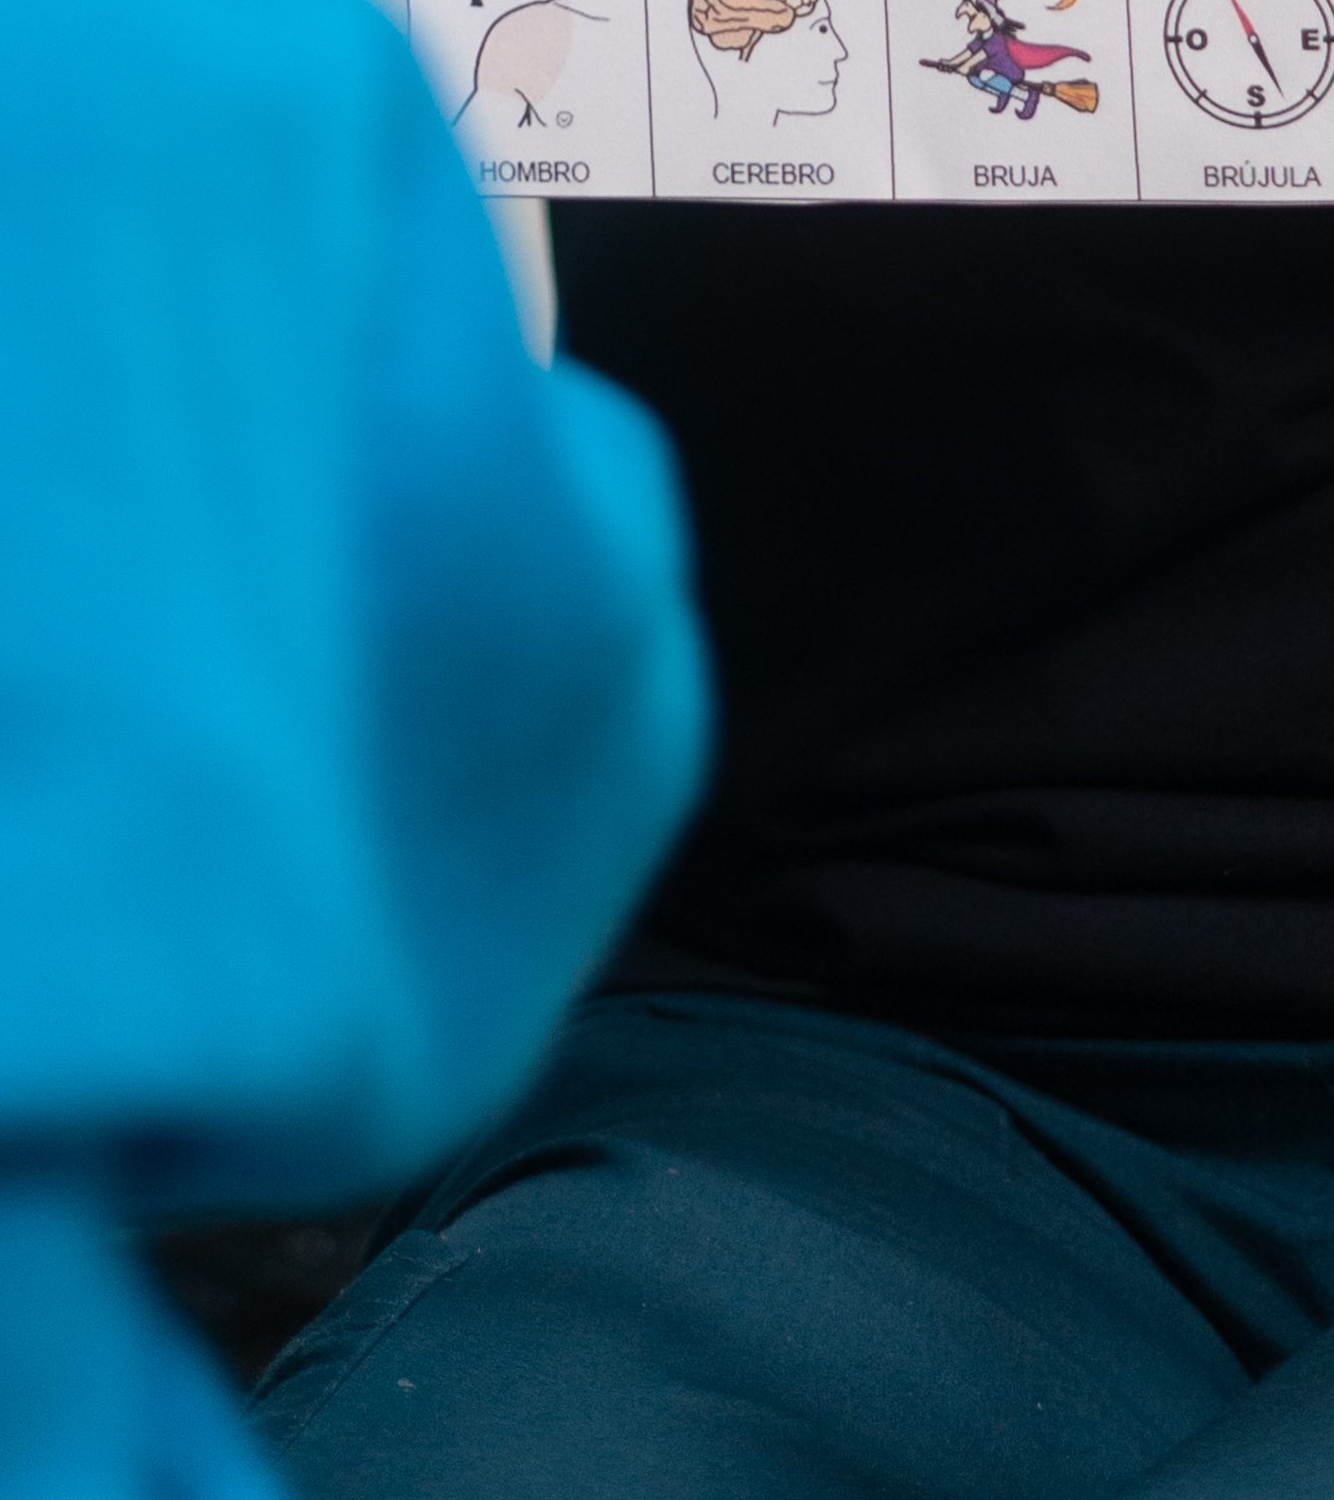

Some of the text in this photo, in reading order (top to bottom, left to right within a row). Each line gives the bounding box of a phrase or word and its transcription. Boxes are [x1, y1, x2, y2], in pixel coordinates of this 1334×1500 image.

[1185, 28, 1209, 51] O
[1300, 28, 1321, 51] E
[1246, 84, 1266, 108] S
[480, 160, 591, 184] HOMBRO
[711, 161, 835, 185] CEREBRO
[973, 163, 1058, 187] BRUJA
[1202, 158, 1323, 189] BRÚJULA
